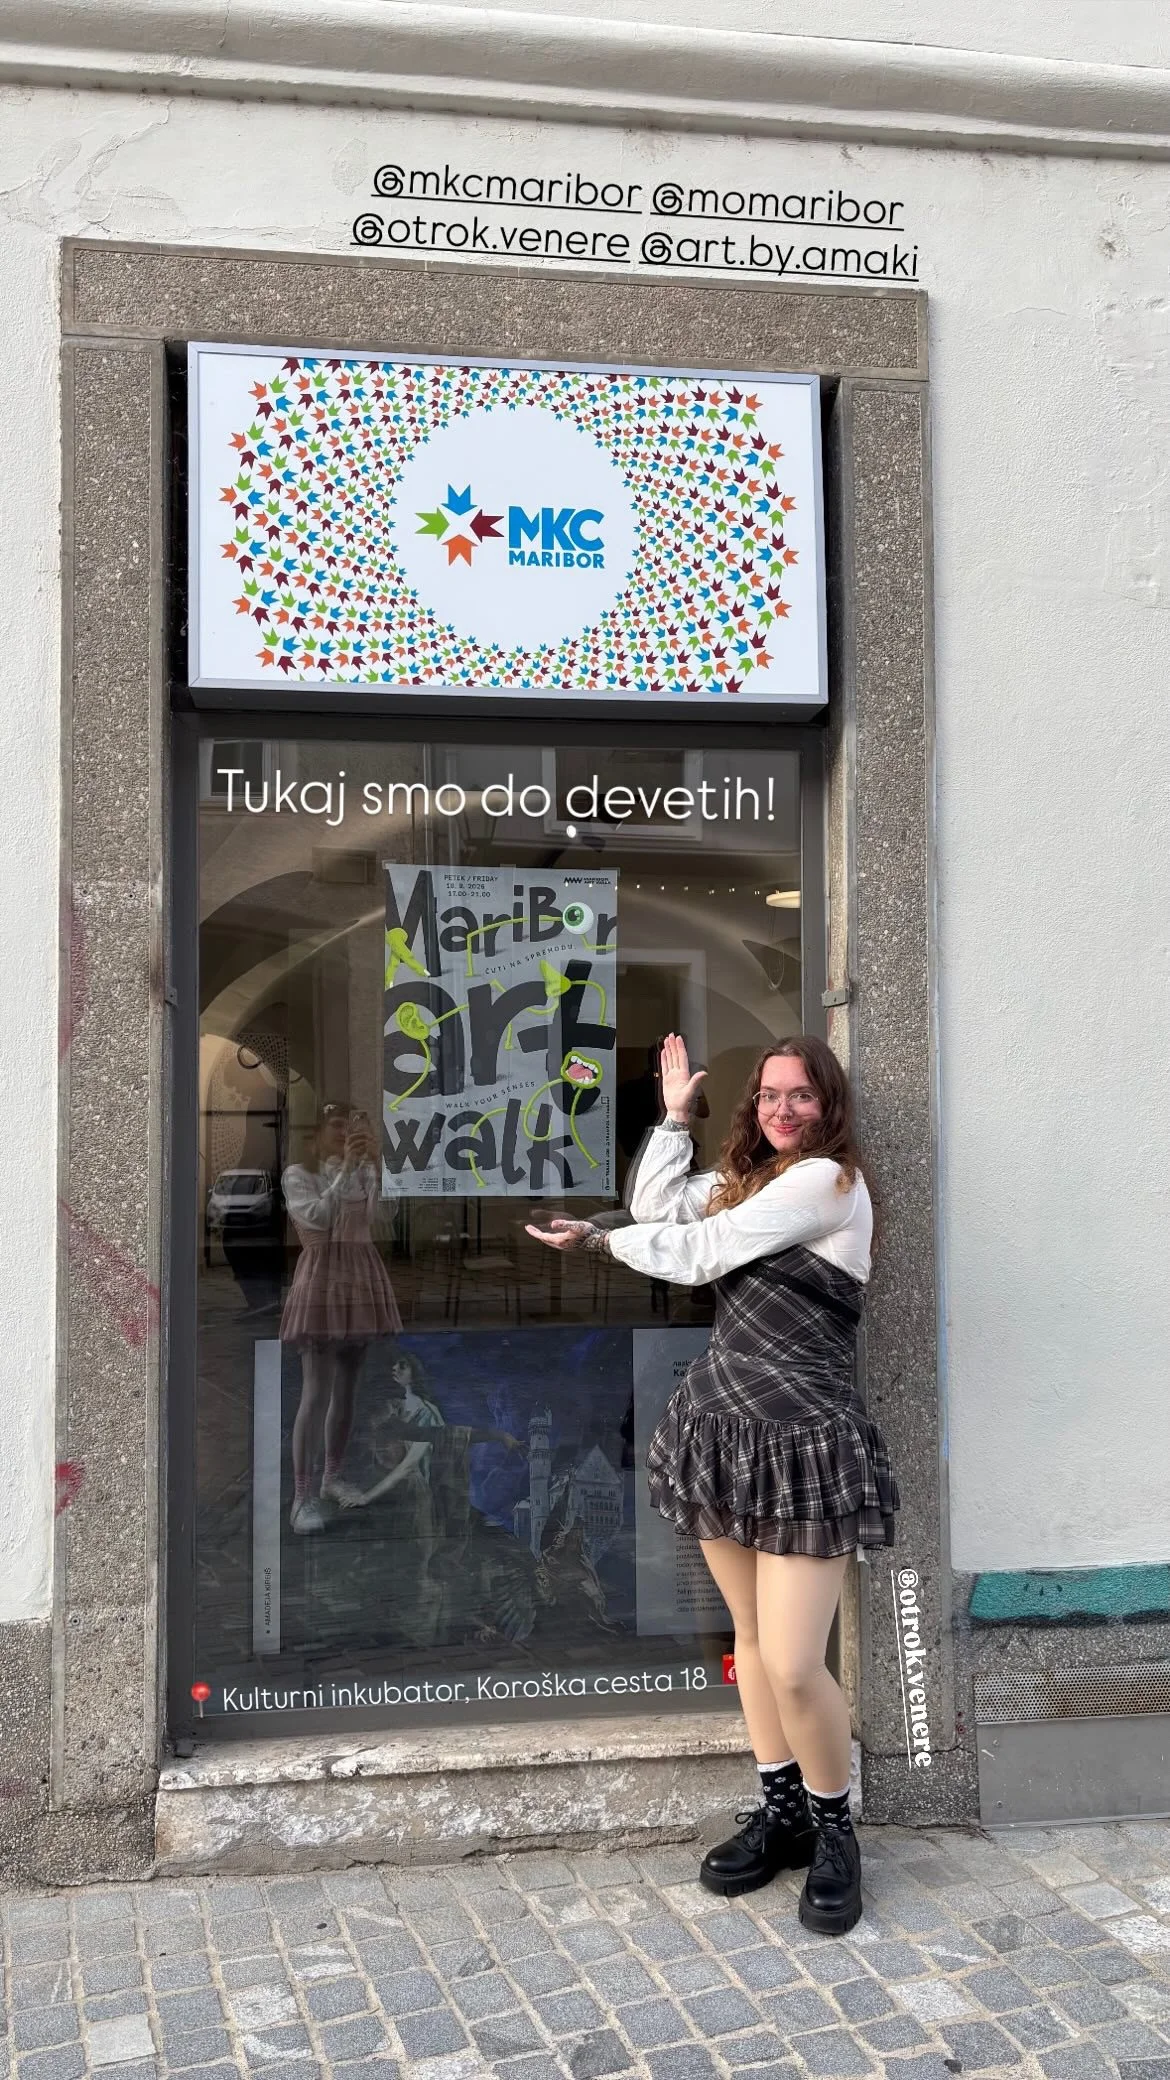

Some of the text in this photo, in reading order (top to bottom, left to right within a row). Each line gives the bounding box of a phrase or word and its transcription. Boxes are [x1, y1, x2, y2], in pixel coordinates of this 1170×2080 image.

[508, 505, 605, 552] MKC
[508, 550, 605, 569] MARIBOR
[444, 874, 466, 882] PETEK
[467, 883, 485, 891] 2026
[509, 959, 522, 969] NA
[383, 958, 616, 1116] art
[445, 1081, 536, 1109] WALK YOUR SENSES
[382, 1098, 575, 1190] walk
